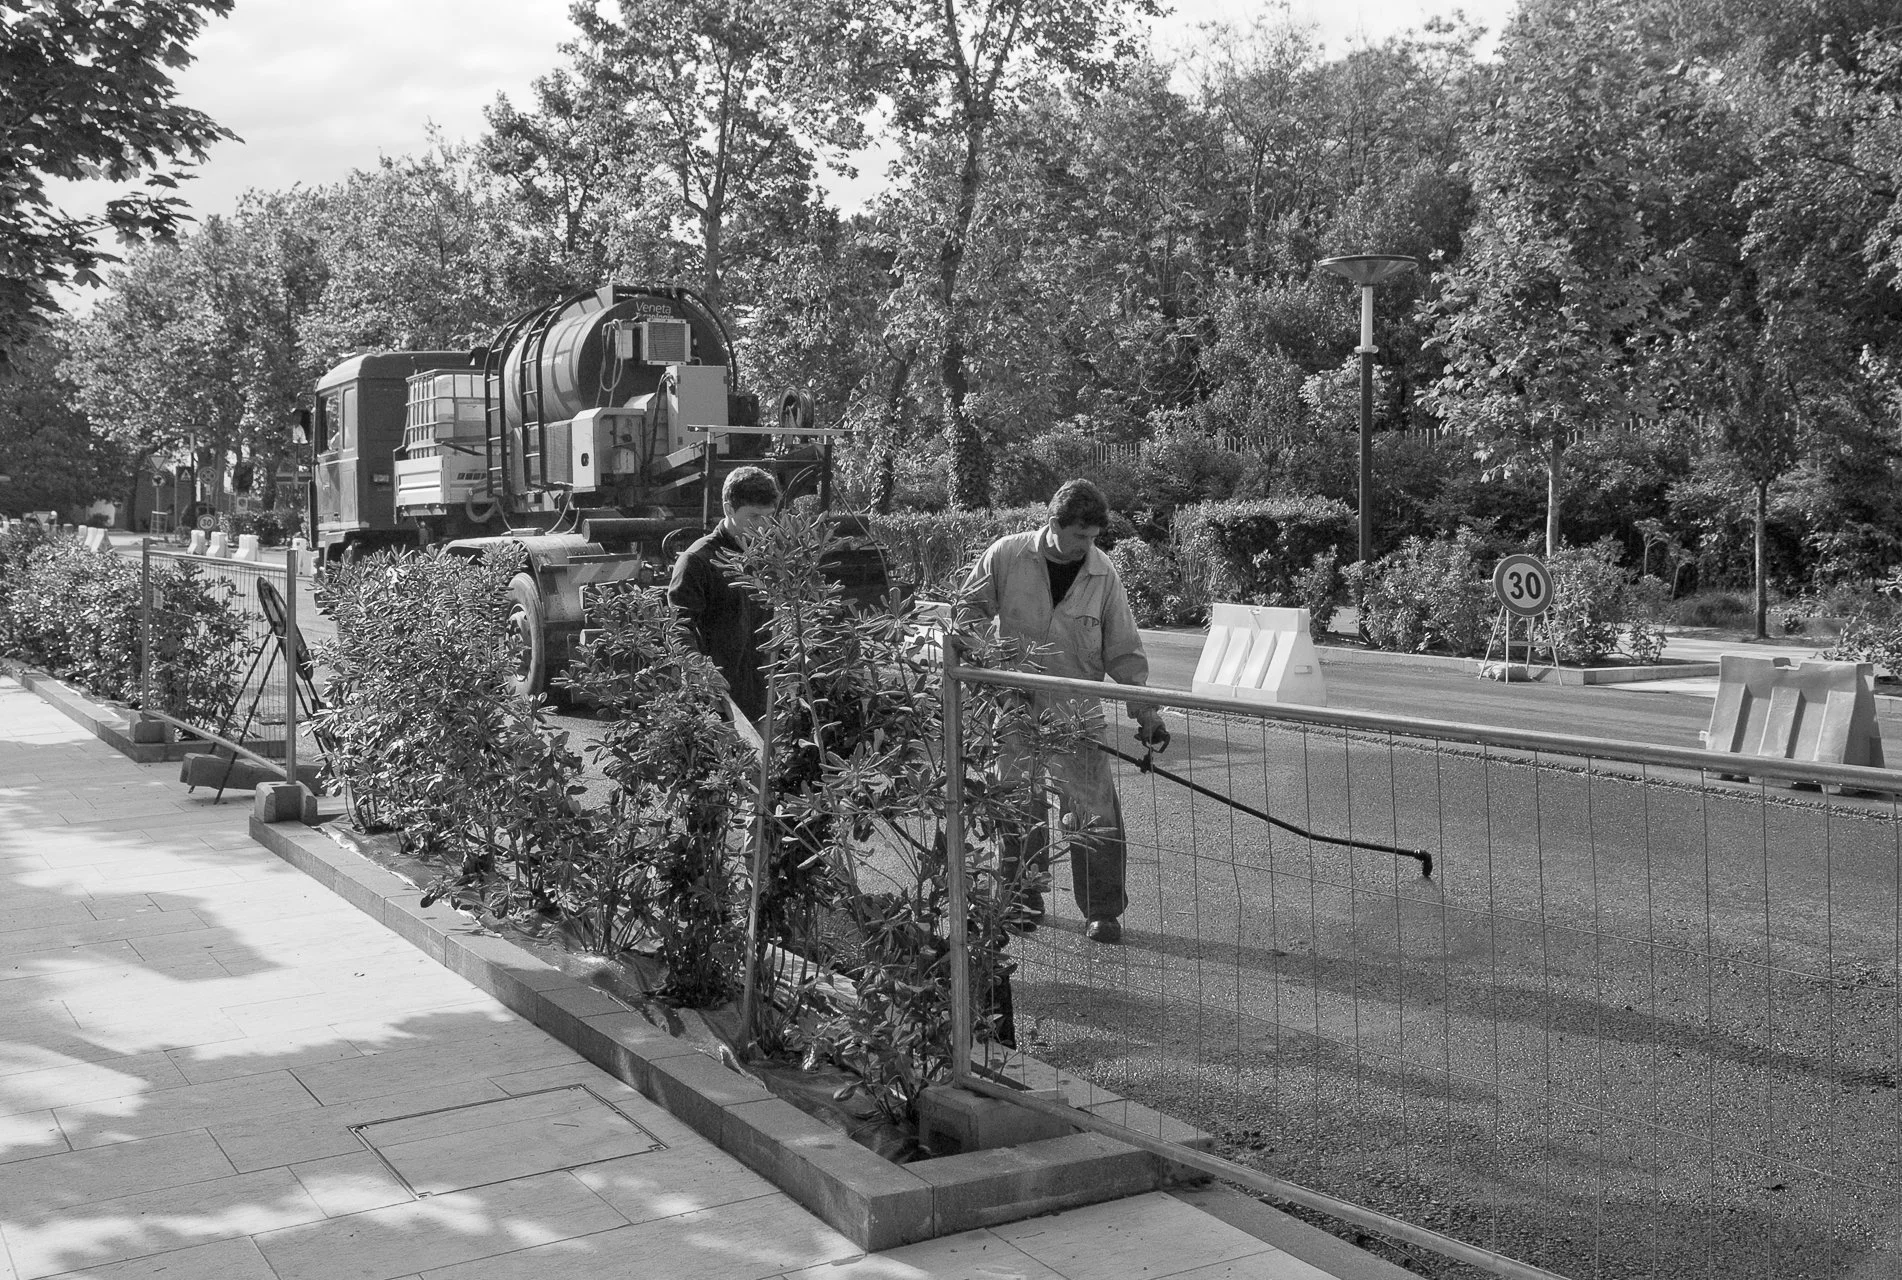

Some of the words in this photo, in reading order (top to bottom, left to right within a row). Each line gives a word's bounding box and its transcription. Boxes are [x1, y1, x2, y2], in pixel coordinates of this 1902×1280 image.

[636, 301, 671, 314] Veneta
[202, 519, 212, 527] 30
[1509, 572, 1541, 600] 30
